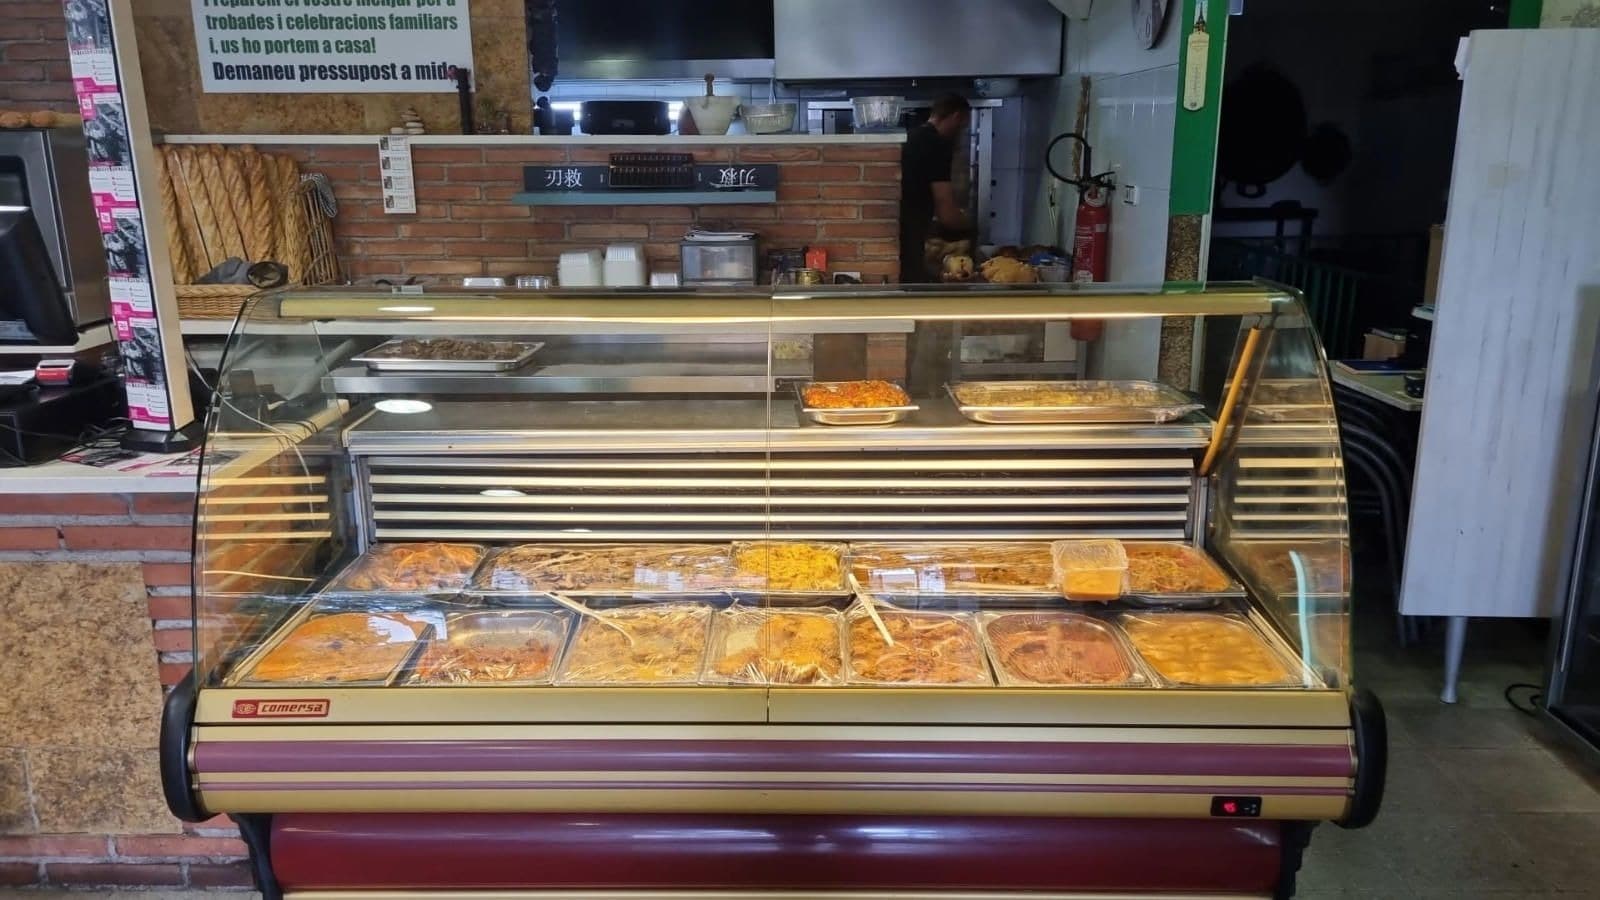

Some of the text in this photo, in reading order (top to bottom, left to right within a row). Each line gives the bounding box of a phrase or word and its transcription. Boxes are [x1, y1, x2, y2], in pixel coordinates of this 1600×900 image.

[206, 13, 458, 30] trobades i celebracions familiars
[209, 37, 376, 55] i, us ho portem a casa!
[212, 62, 296, 80] Demaneu
[299, 62, 398, 82] pressupost
[401, 64, 412, 80] a
[261, 703, 323, 713] comersa
